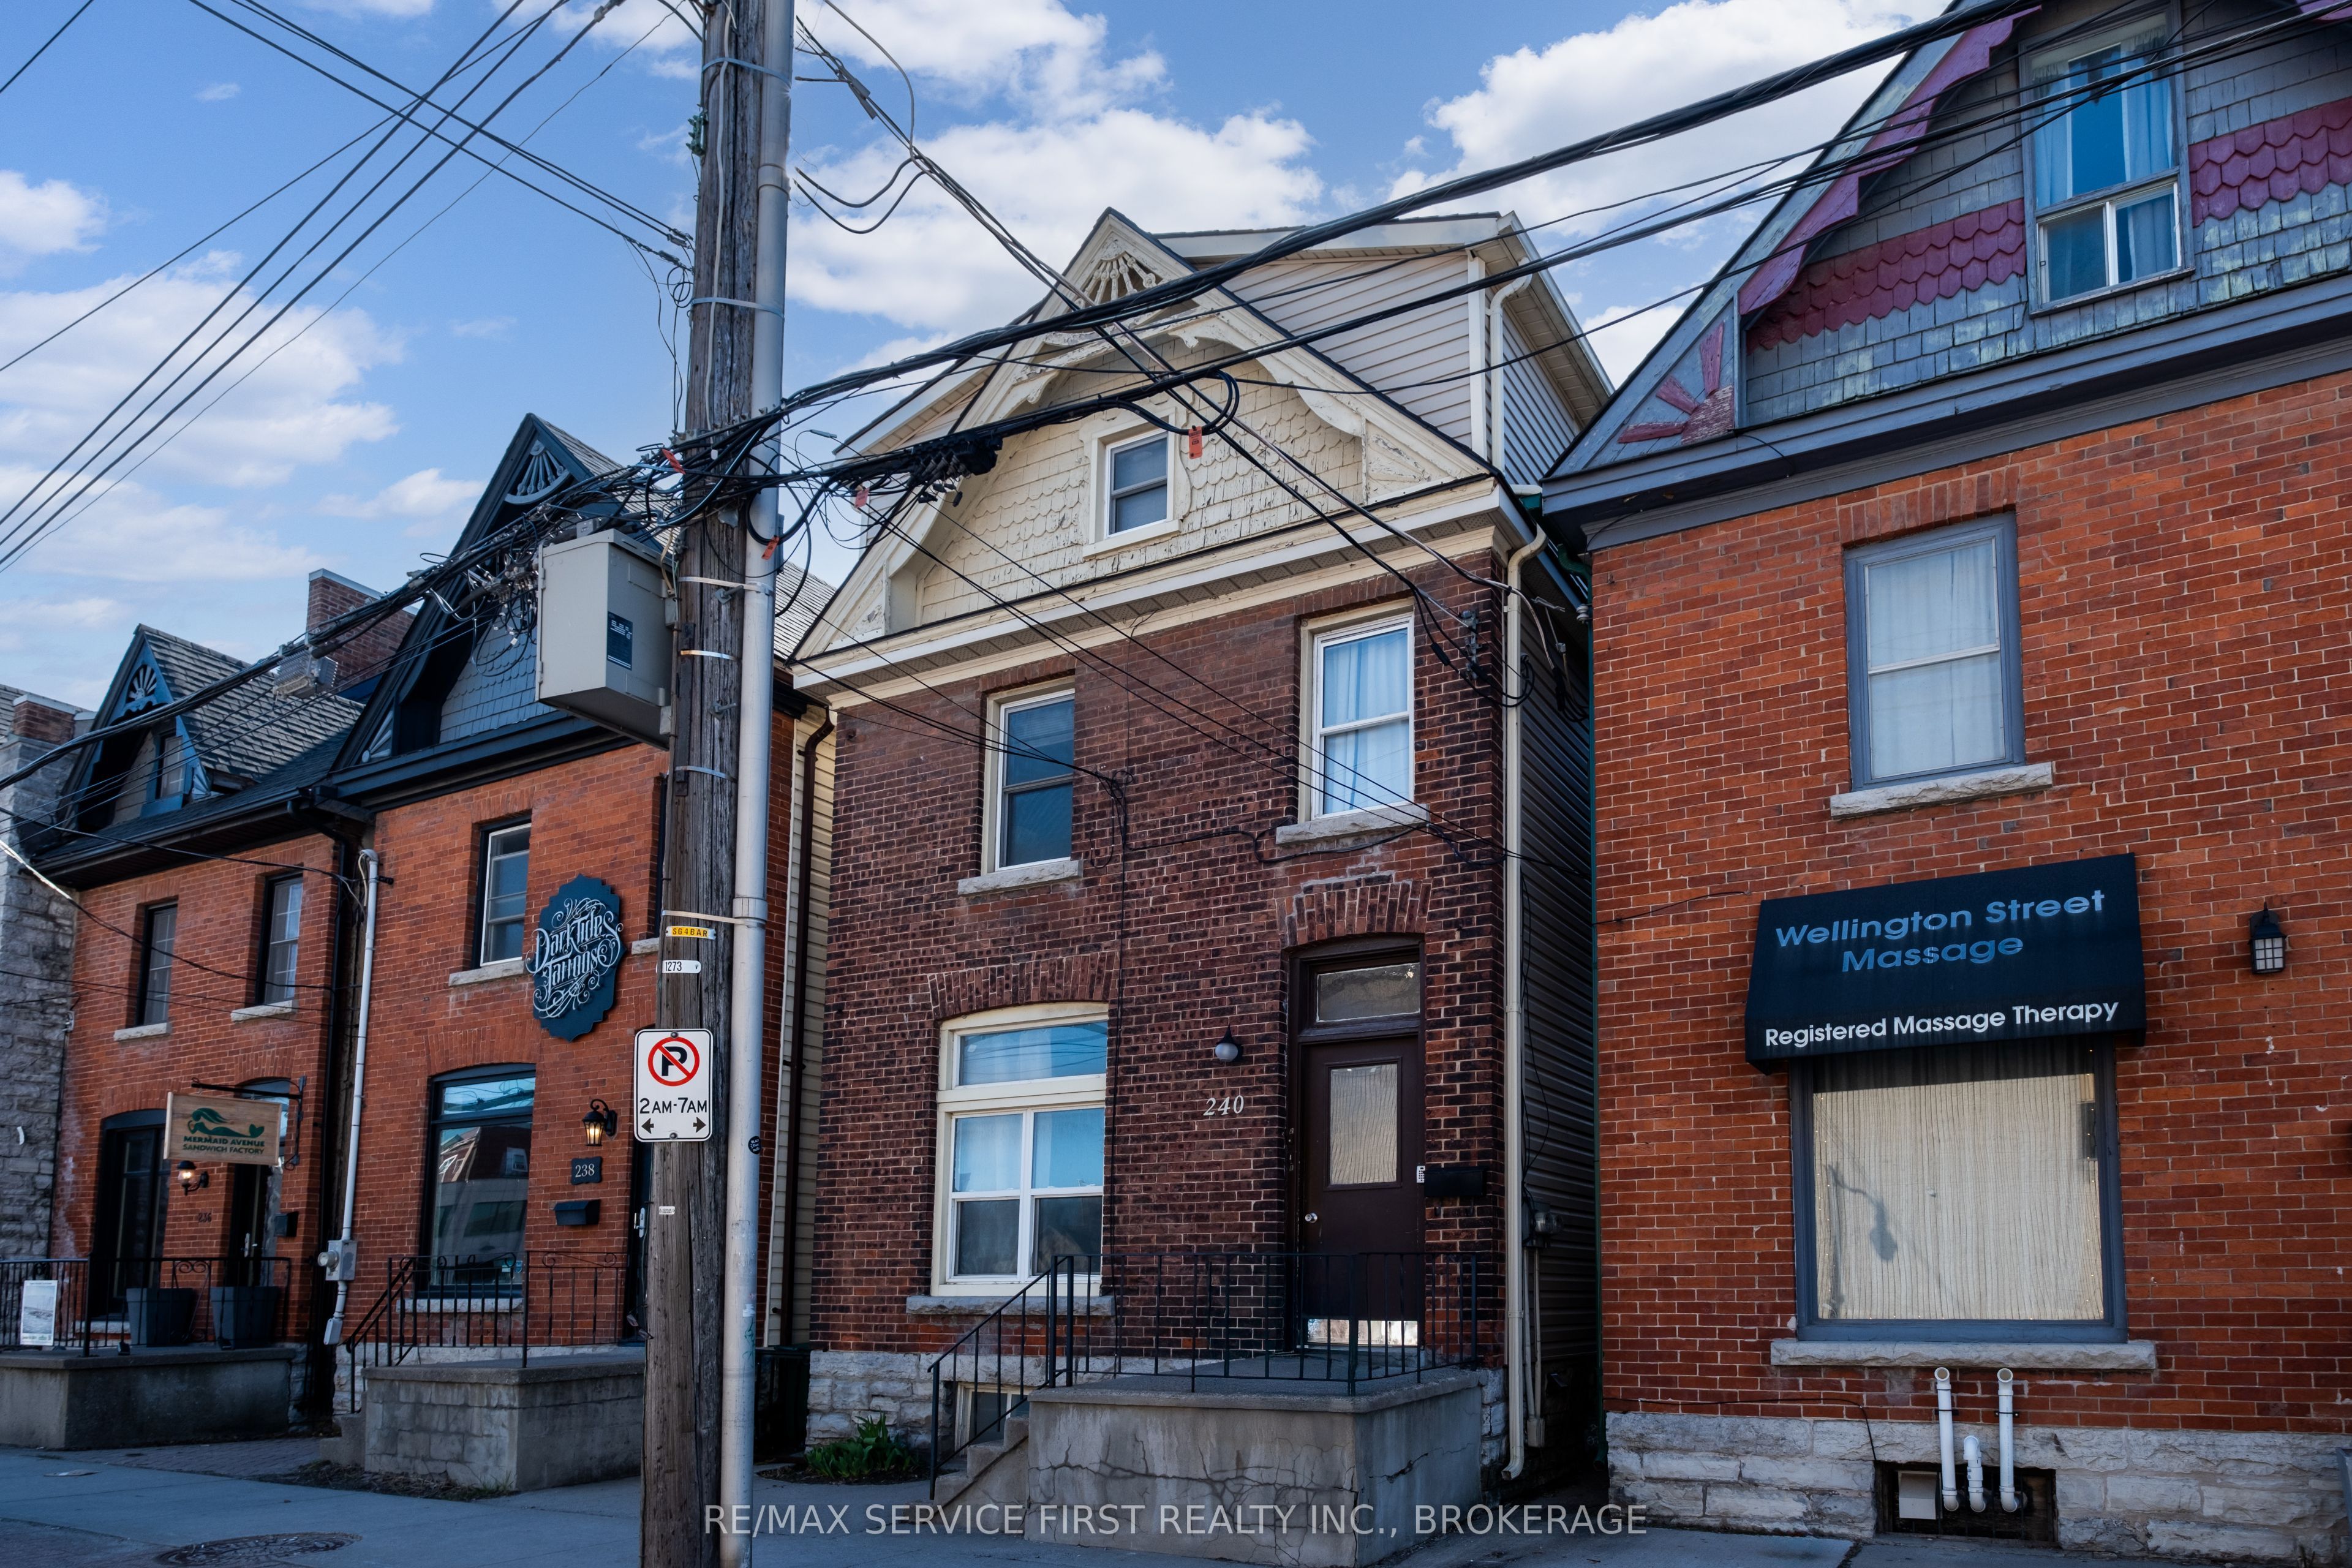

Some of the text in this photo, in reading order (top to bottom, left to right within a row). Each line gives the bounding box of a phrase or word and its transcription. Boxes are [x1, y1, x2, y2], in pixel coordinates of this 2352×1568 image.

[1776, 890, 2105, 947] Wellington Street
[1842, 937, 2024, 972] Massage
[665, 961, 682, 972] 1273
[1766, 1002, 2119, 1048] Registered Massage Therapy
[639, 1097, 707, 1114] 2AM-7AM
[1203, 1095, 1244, 1115] 240
[183, 1144, 227, 1152] SANDWICH
[184, 1136, 228, 1144] MERMAID
[575, 1163, 595, 1177] 238
